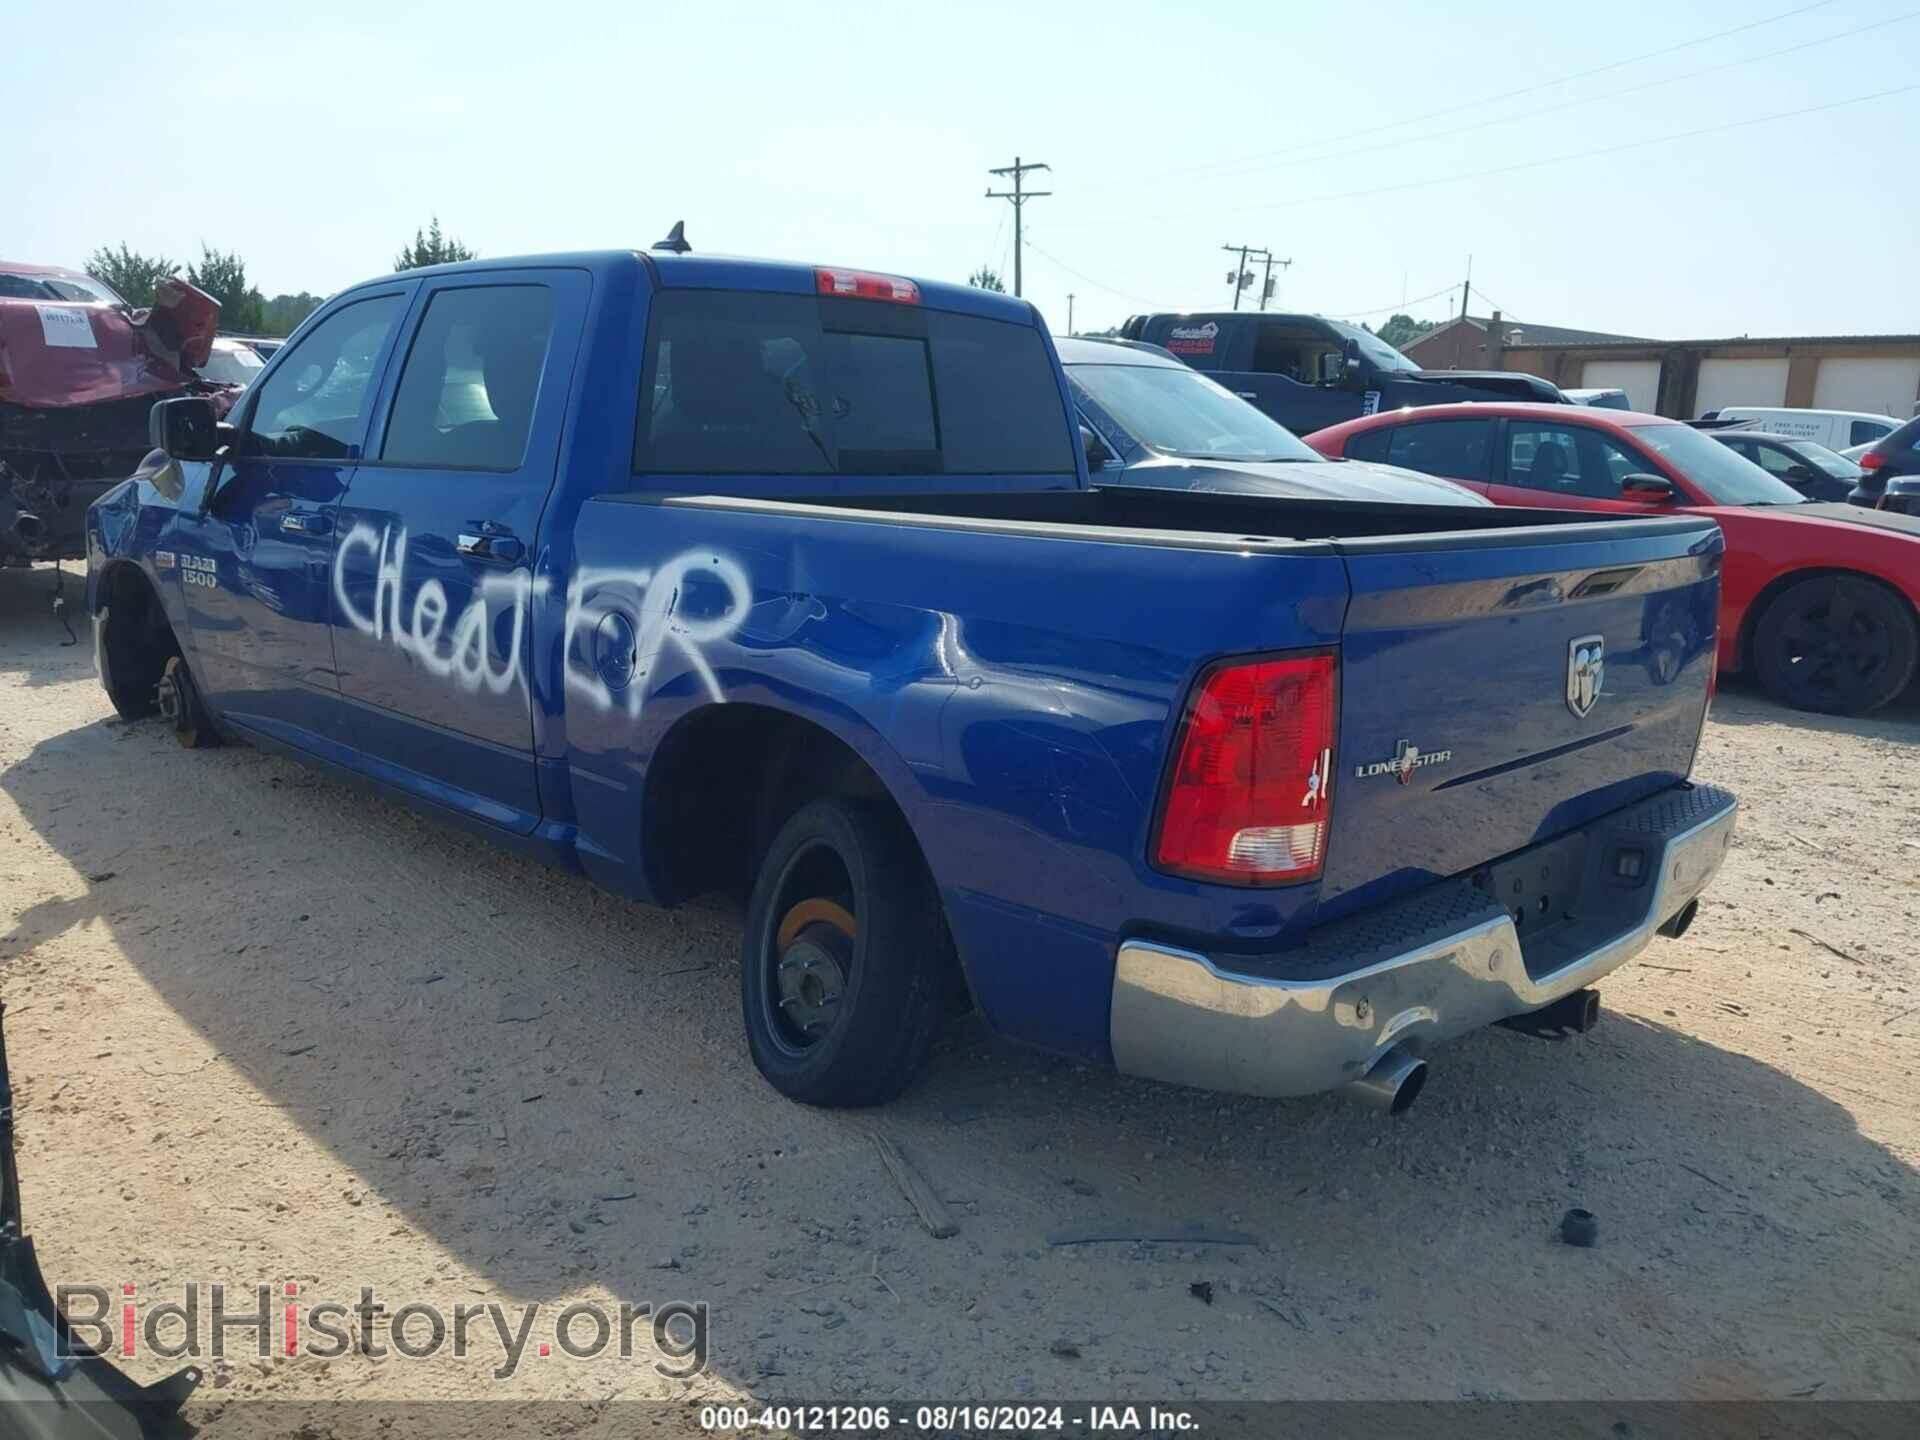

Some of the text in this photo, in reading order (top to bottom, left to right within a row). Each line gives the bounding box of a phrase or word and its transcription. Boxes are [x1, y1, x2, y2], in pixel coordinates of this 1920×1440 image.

[182, 569, 216, 588] 1500
[1355, 750, 1452, 777] LONE STAR
